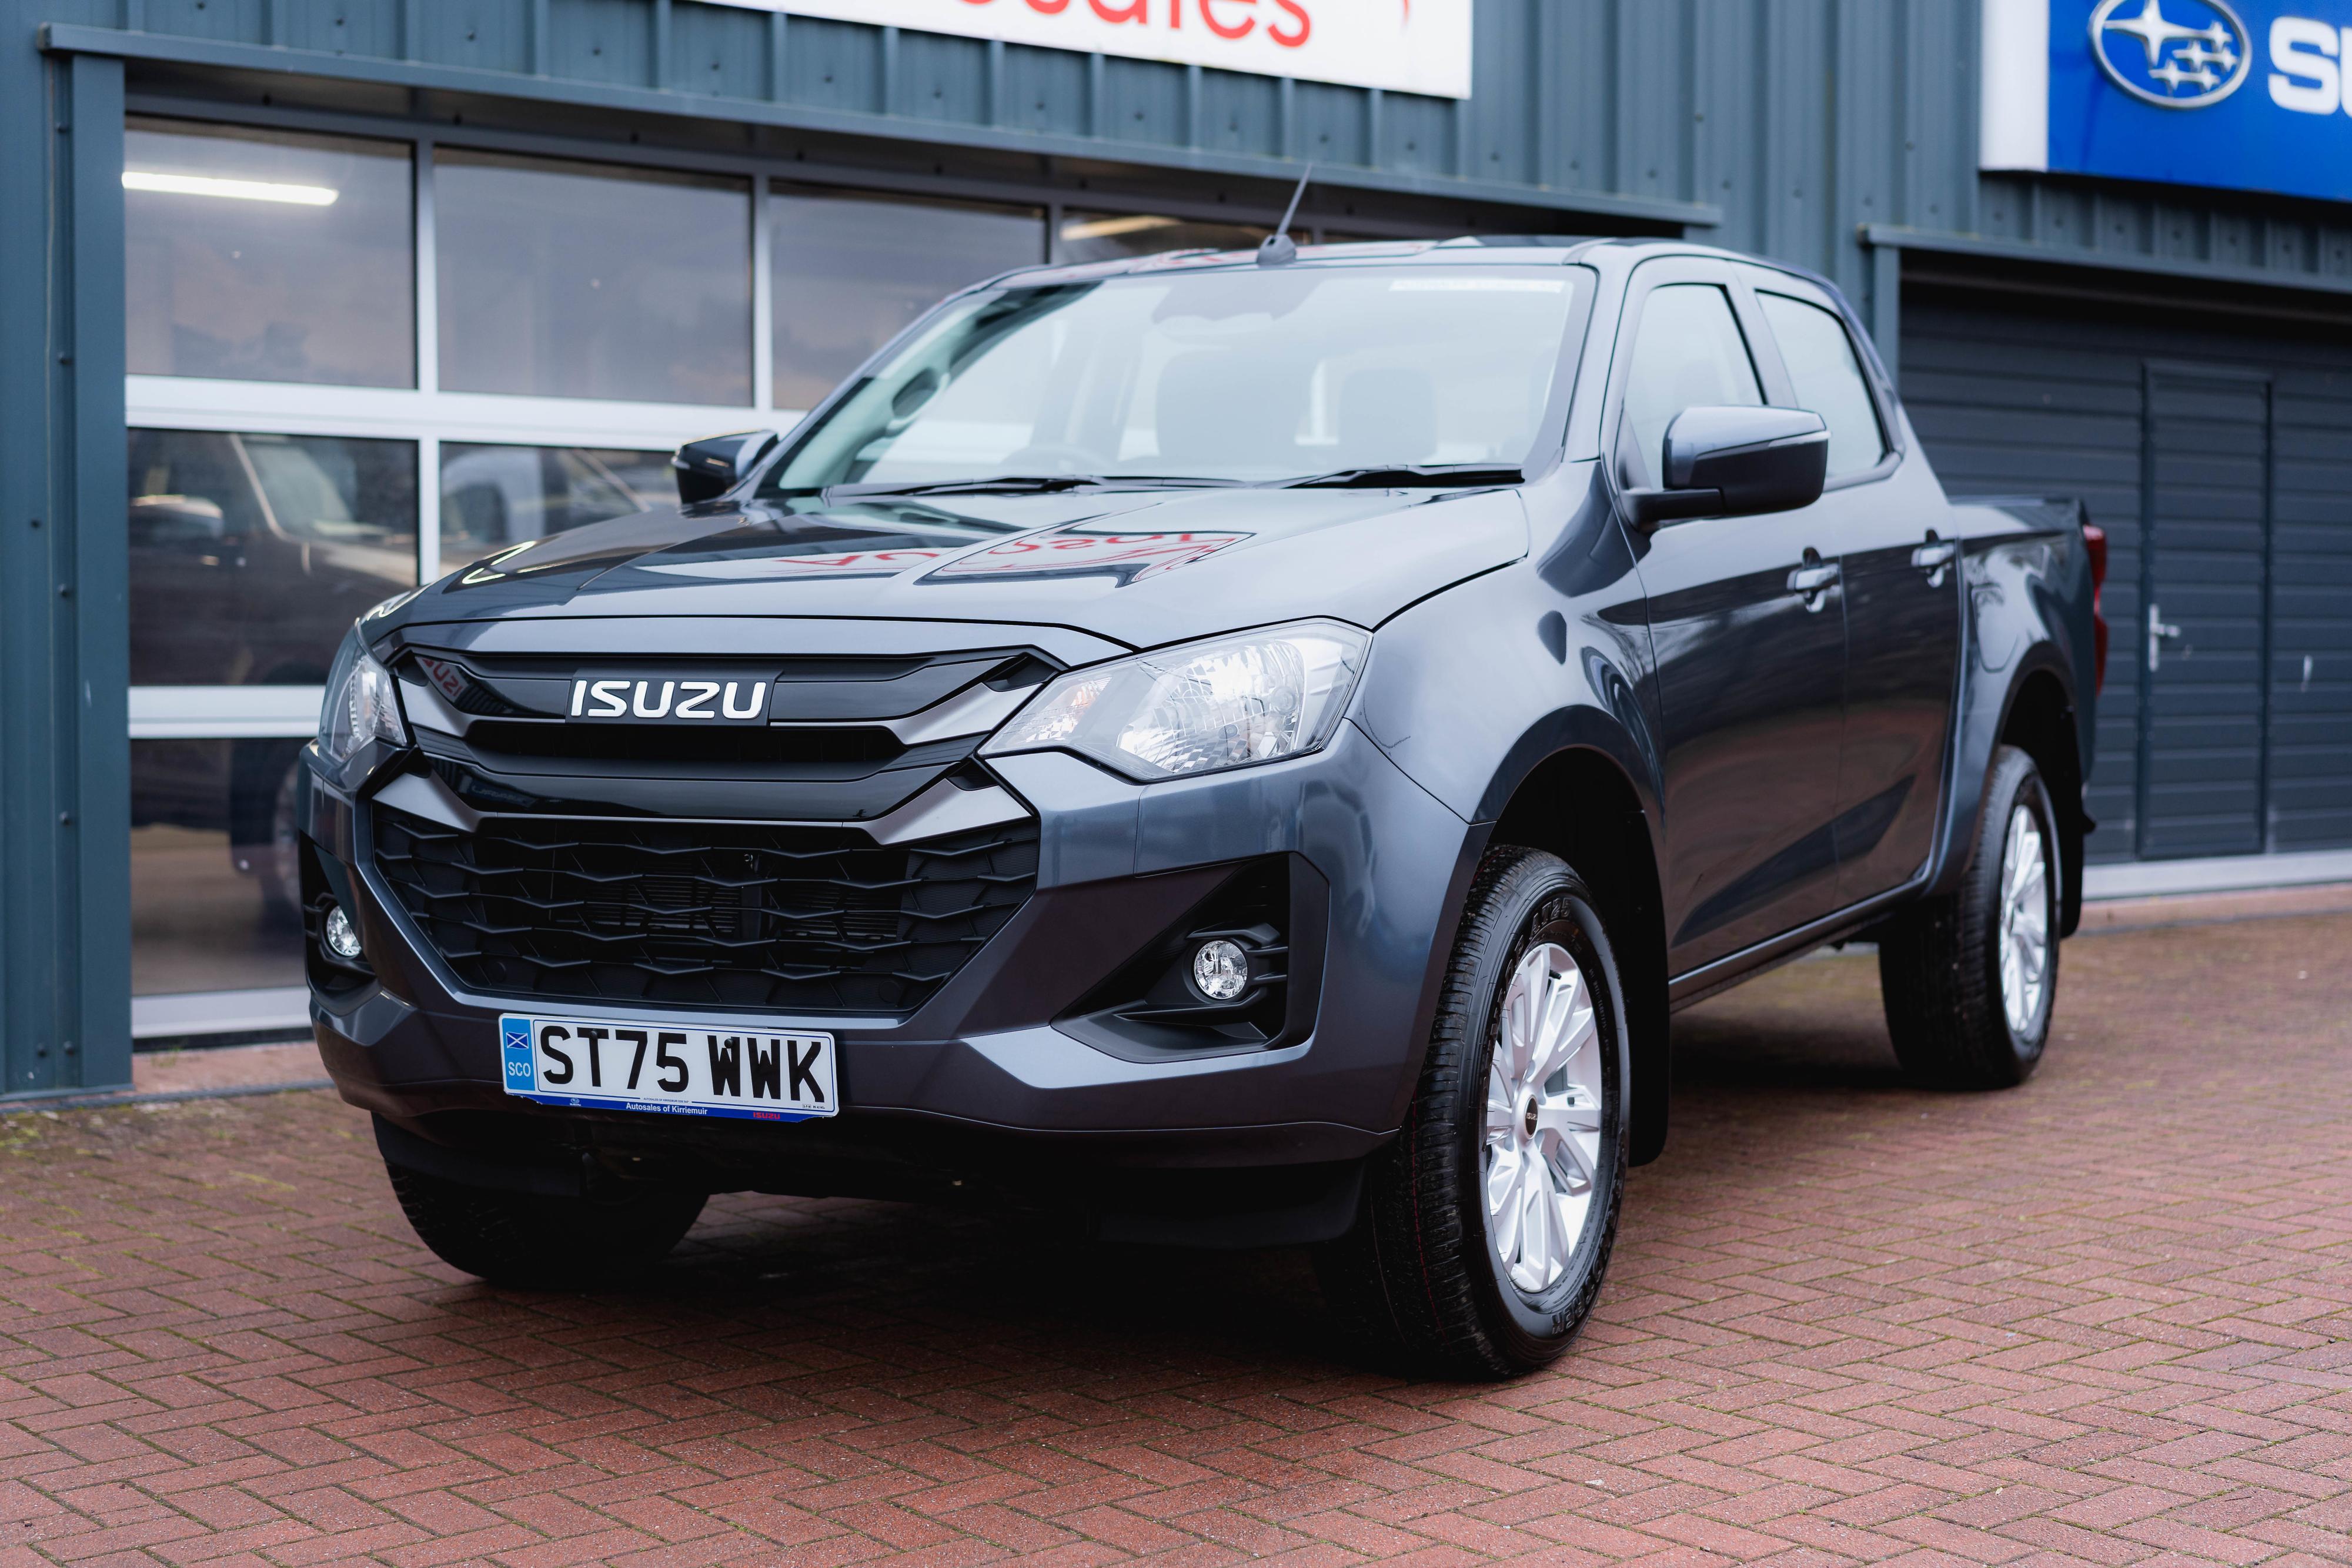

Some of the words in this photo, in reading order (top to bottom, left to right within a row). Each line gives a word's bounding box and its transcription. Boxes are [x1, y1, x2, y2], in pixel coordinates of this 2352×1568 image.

[2268, 15, 2352, 118] S
[571, 680, 766, 719] ISUZU
[508, 1061, 531, 1077] SCO
[539, 1025, 690, 1093] ST75
[707, 1035, 825, 1103] WWK
[626, 1102, 662, 1112] Autosales
[671, 1105, 708, 1115] Kirriemuir
